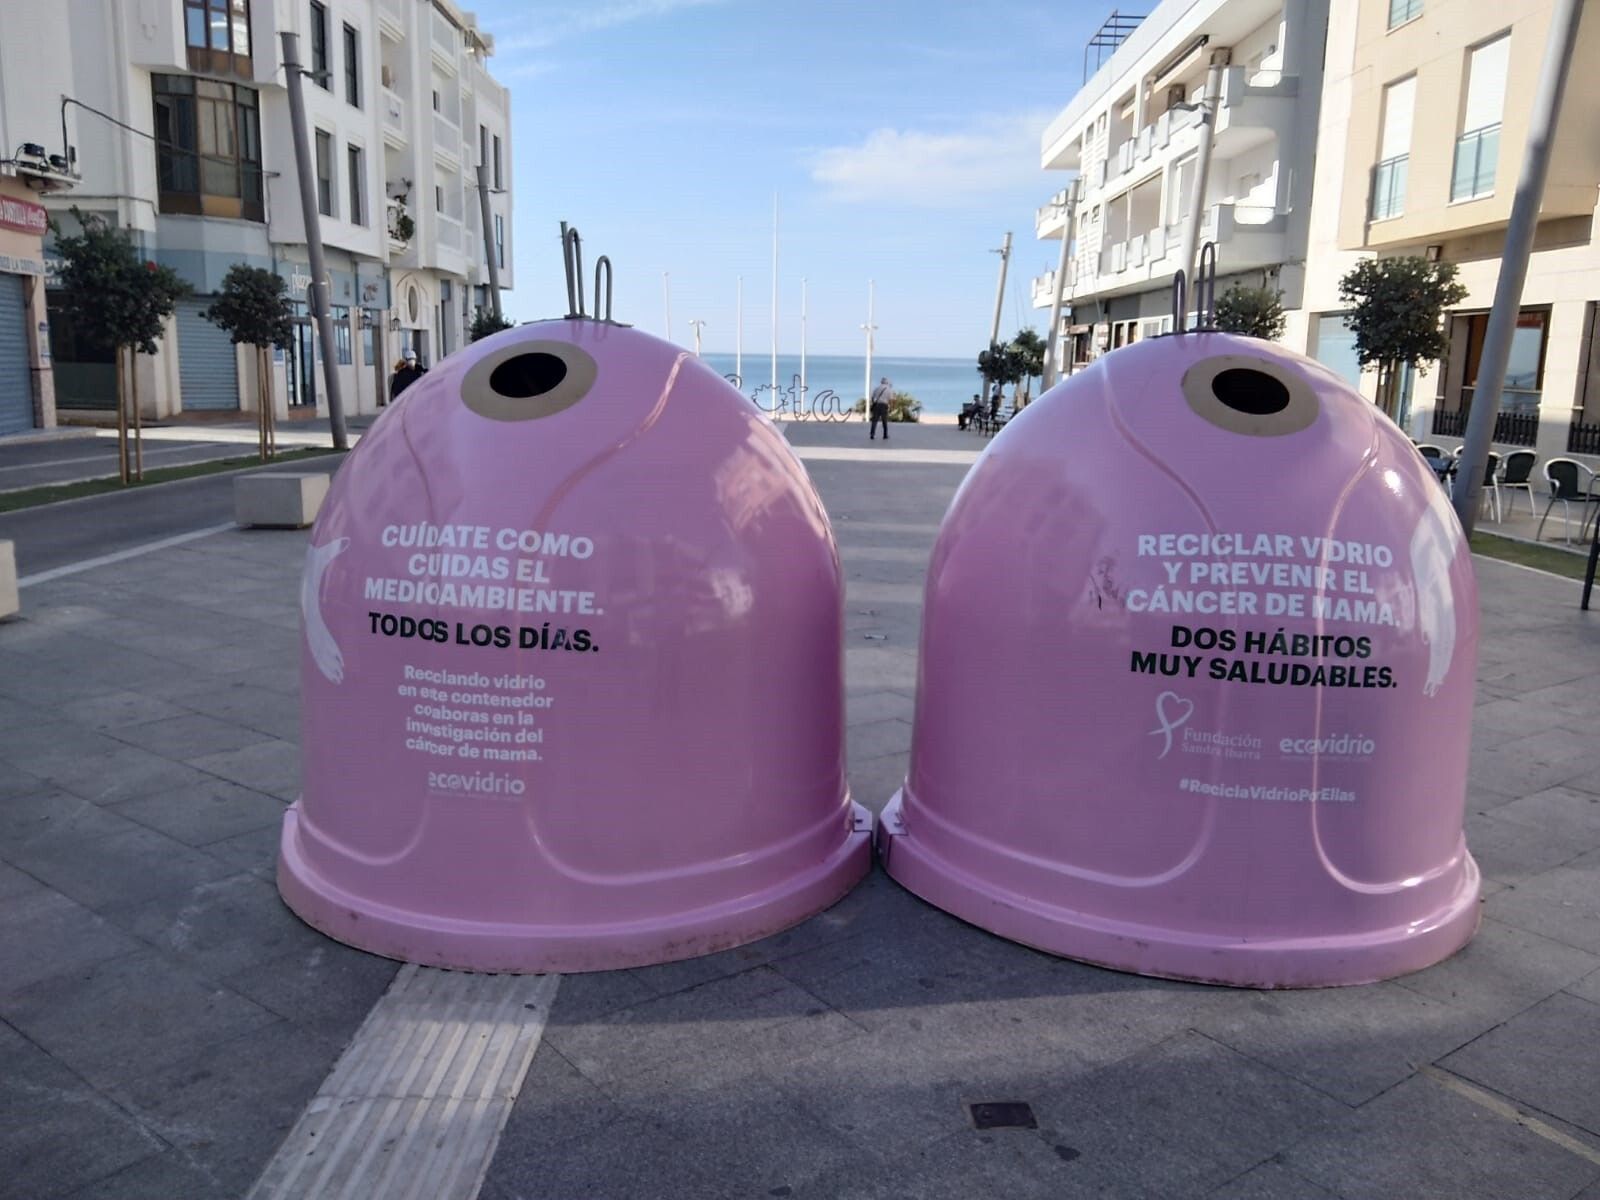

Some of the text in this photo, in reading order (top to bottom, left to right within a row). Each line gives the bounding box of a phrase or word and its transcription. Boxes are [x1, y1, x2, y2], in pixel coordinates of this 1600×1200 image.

[381, 521, 594, 559] CUÍDATE COMO
[1137, 533, 1394, 568] RECICLAR VIDRIO
[408, 553, 550, 584] CUIDAS EL
[1163, 561, 1374, 594] Y PREVENIR EL
[364, 577, 604, 615] MEDIOAMBIENTE.
[1126, 585, 1401, 628] CÁNCER DE MAMA.
[368, 611, 599, 652] TODOS LOS DÍAS.
[1170, 625, 1372, 659] DOS HÁBITOS
[404, 665, 546, 690] Recclando vidrio
[1130, 651, 1398, 689] MUY SALUDABLES.
[397, 684, 417, 697] en
[451, 692, 554, 708] contenedor
[414, 703, 534, 726] coaboras en la
[515, 728, 544, 744] del
[1183, 727, 1375, 755] Fundación ecovidrio
[458, 743, 480, 759] de
[483, 747, 543, 761] mama.
[428, 771, 526, 795] ecovidrio
[1179, 778, 1356, 803] #ReciclaVidrioPorEllas
